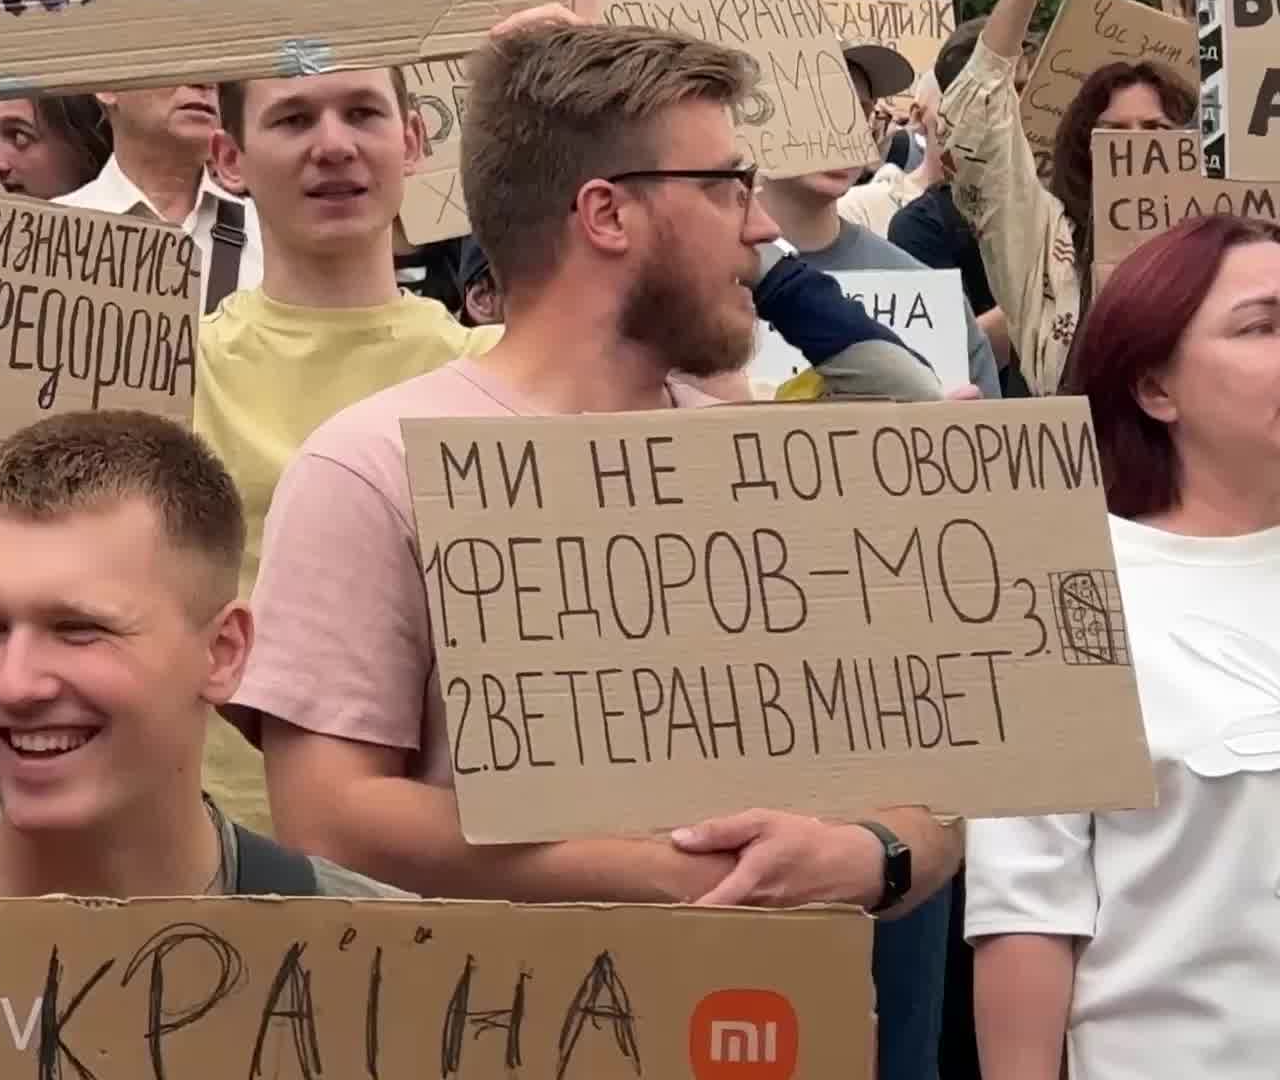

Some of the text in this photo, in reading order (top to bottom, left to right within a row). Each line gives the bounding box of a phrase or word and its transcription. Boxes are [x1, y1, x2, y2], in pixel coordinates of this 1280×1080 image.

[440, 420, 1101, 511] МИ НЕ ДОГОВОРИЛИ
